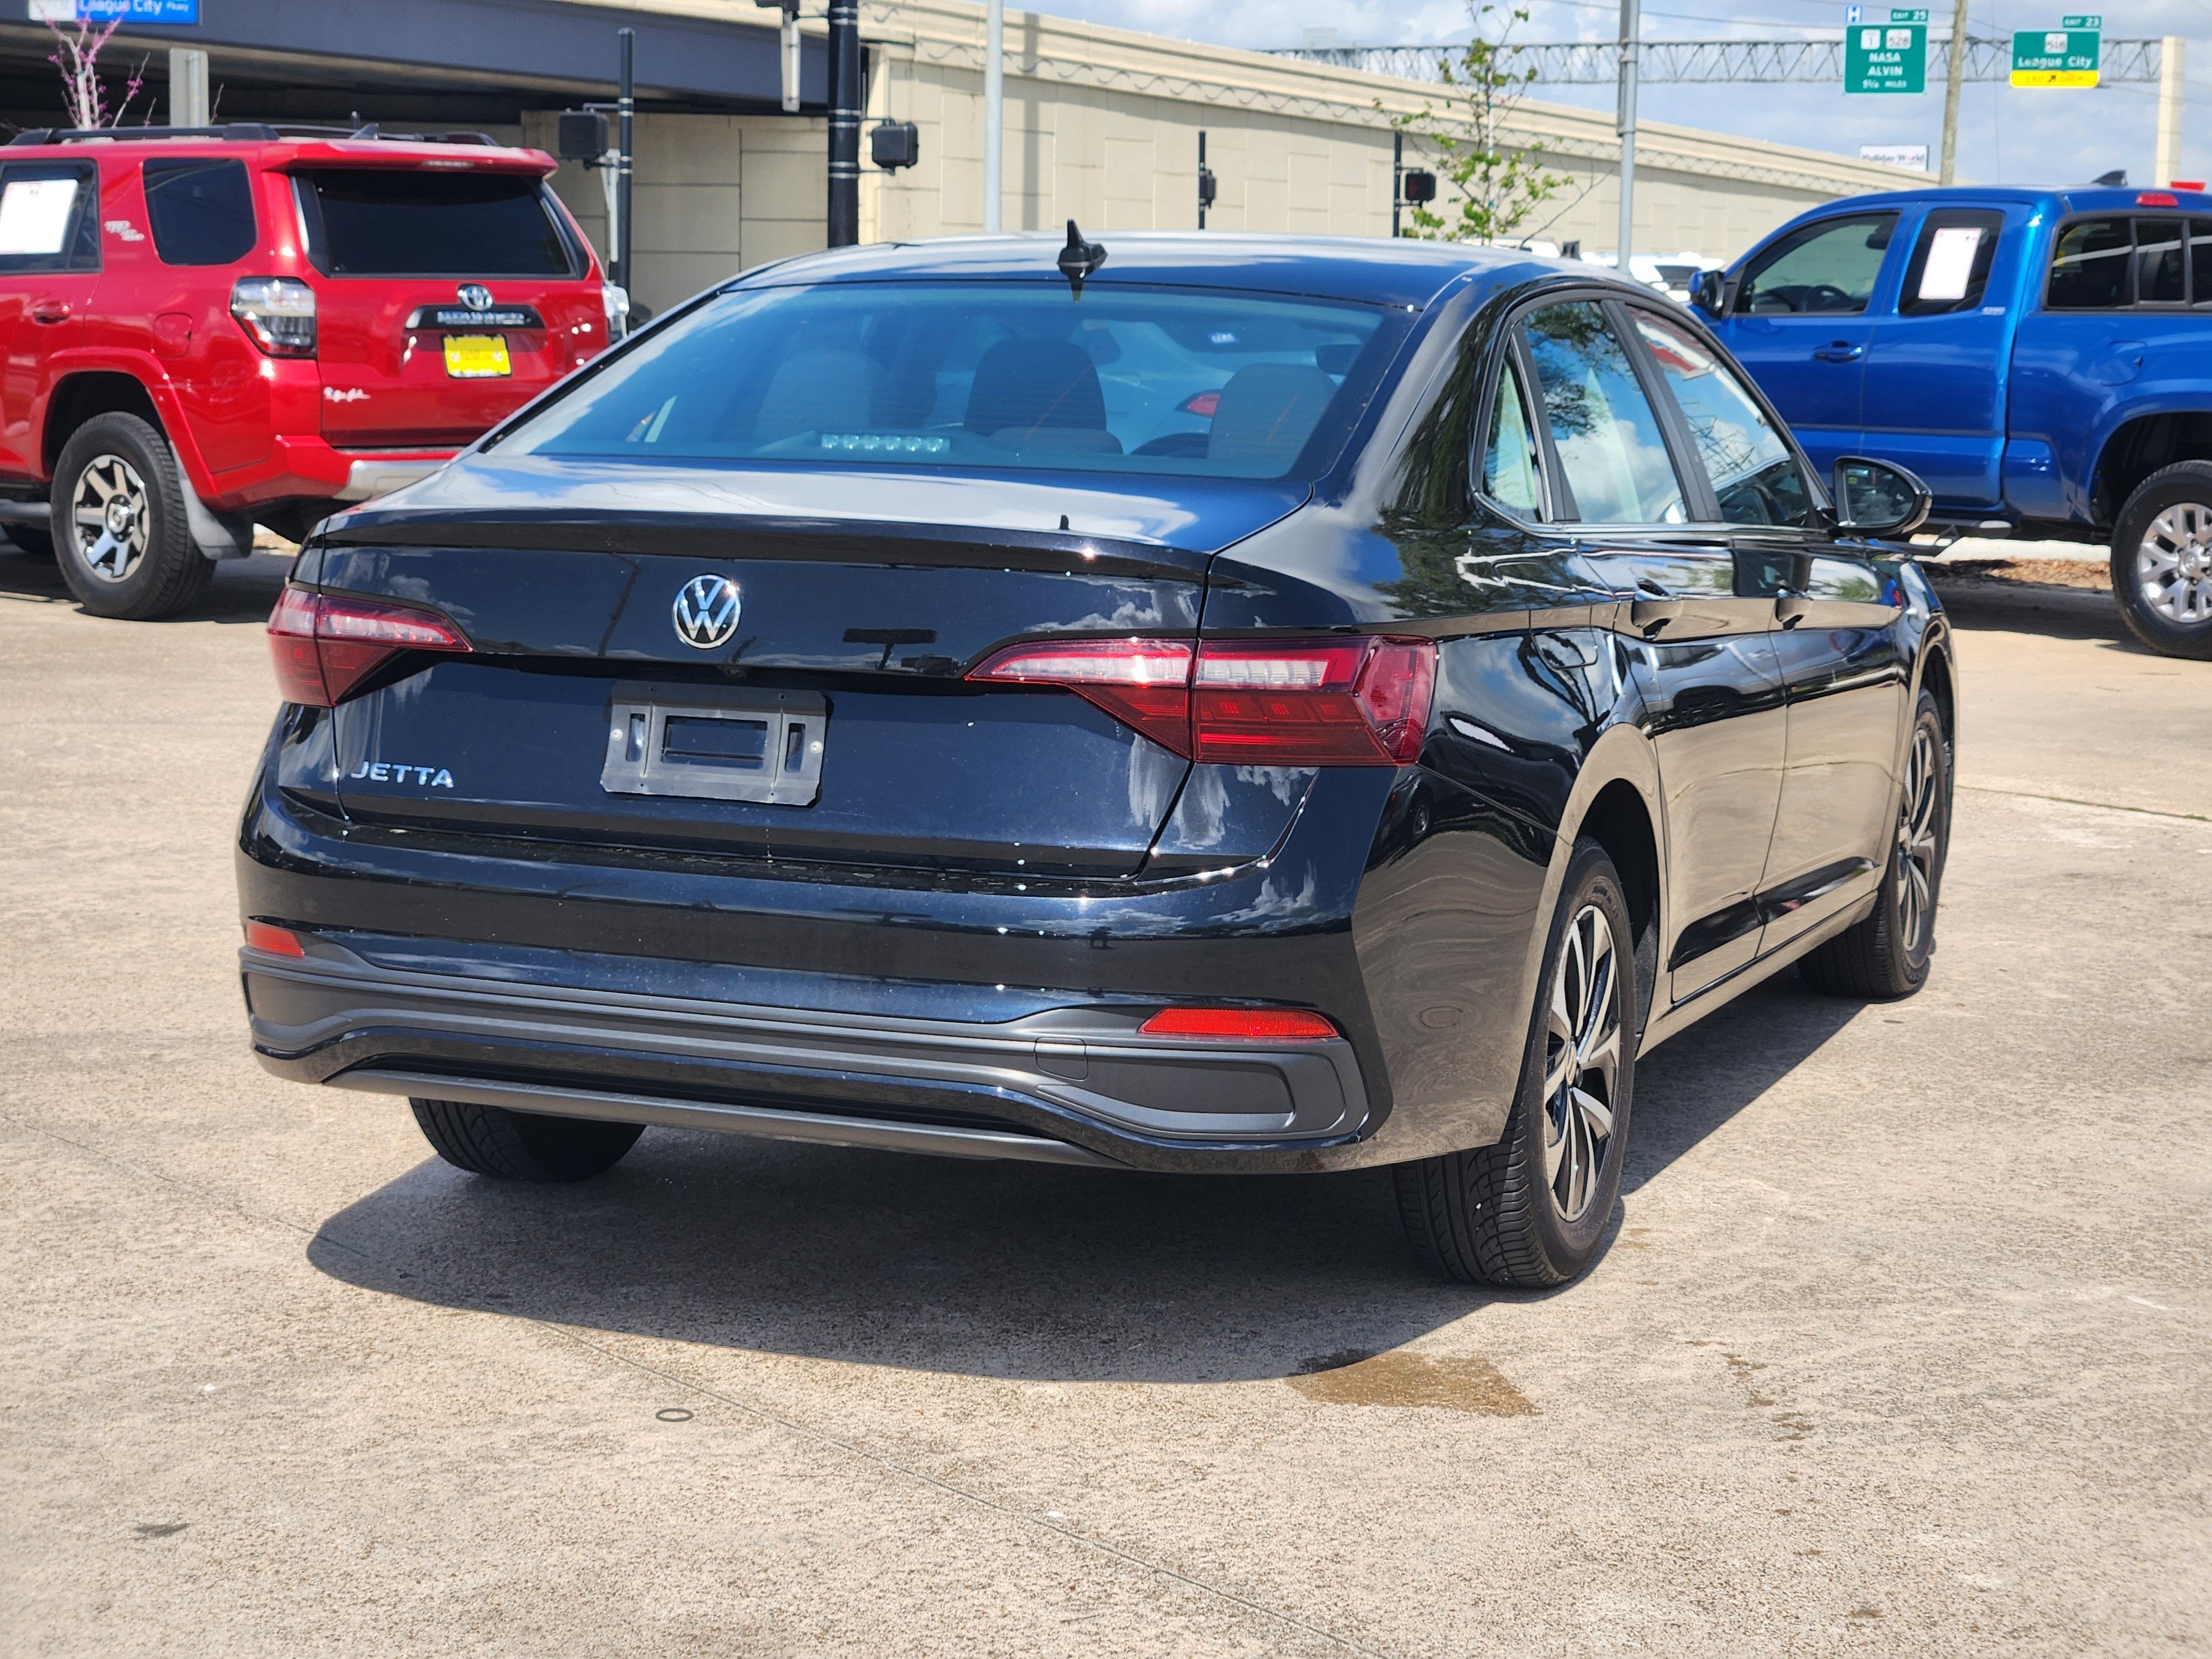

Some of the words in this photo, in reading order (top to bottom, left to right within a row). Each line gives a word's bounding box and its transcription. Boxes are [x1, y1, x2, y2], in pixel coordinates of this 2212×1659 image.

[133, 0, 163, 15] City
[1868, 52, 1901, 63] NASA
[2018, 56, 2063, 69] League
[2067, 55, 2093, 69] City
[1867, 65, 1903, 76] ALVIN
[350, 761, 455, 789] JETTA
